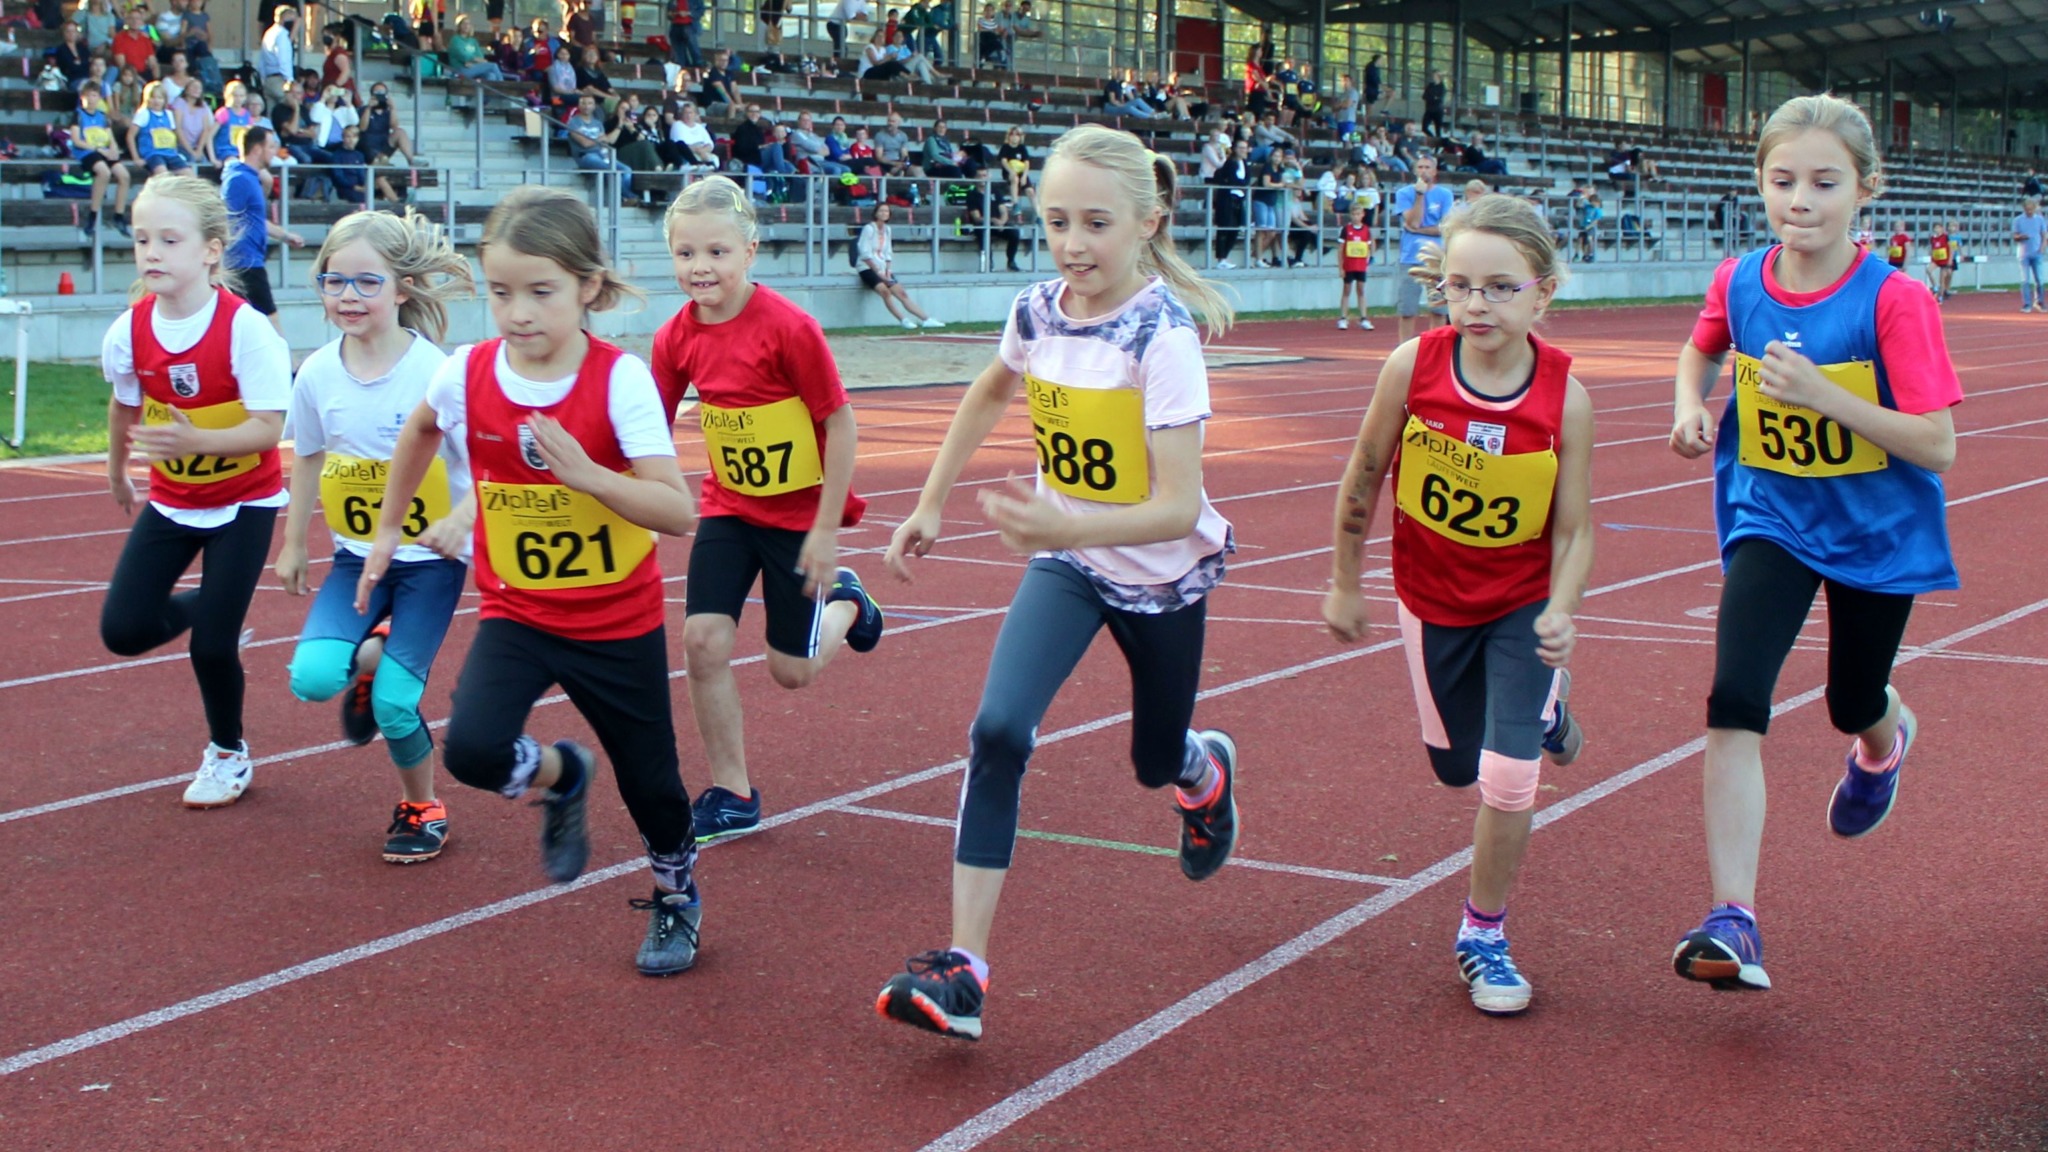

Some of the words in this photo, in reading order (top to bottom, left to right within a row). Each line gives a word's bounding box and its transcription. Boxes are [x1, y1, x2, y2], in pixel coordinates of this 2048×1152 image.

[721, 440, 794, 488] 587
[1033, 422, 1117, 491] 588
[1757, 409, 1853, 466] 530
[344, 496, 429, 537] 63
[1421, 473, 1520, 539] 623
[516, 524, 615, 580] 621
